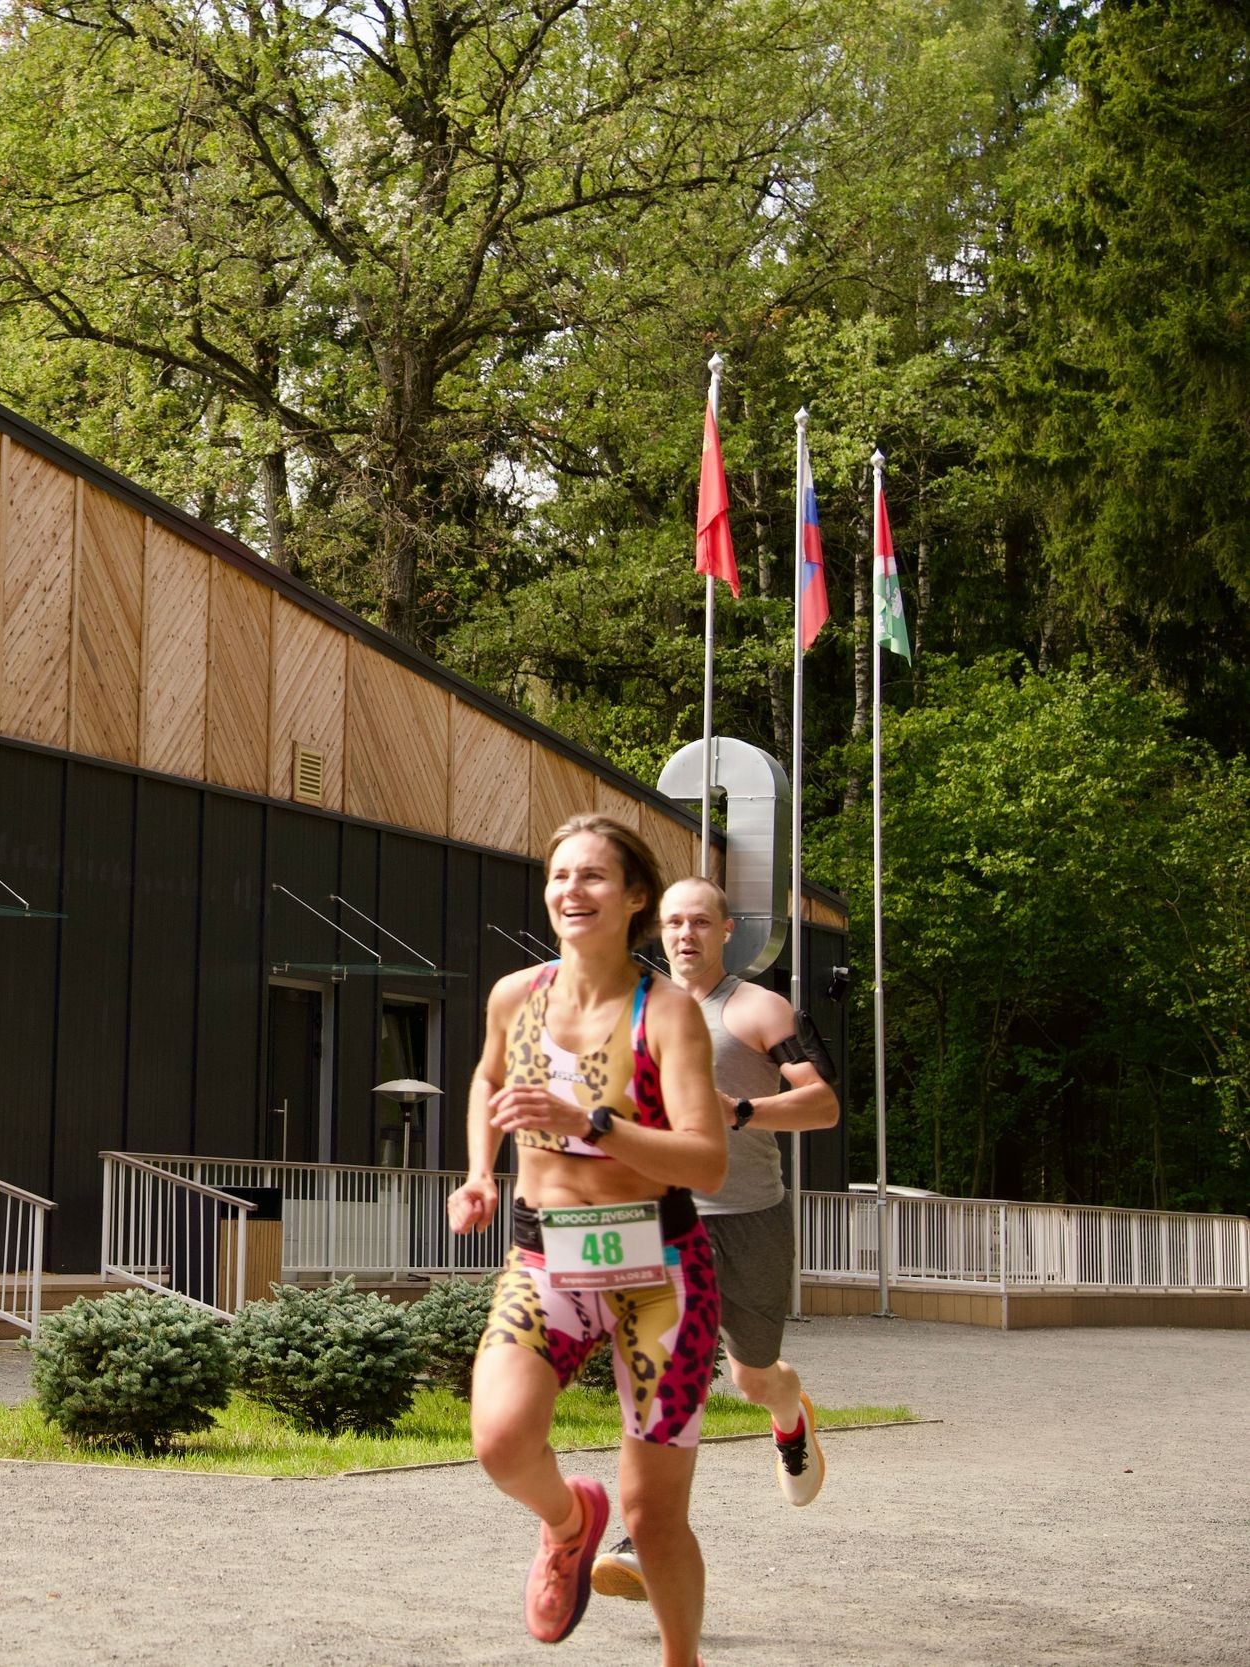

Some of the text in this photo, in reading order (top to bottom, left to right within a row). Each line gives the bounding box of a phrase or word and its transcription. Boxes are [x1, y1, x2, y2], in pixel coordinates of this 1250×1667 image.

[551, 1208, 645, 1225] КРОСС ДУБКИ
[581, 1230, 624, 1265] 48
